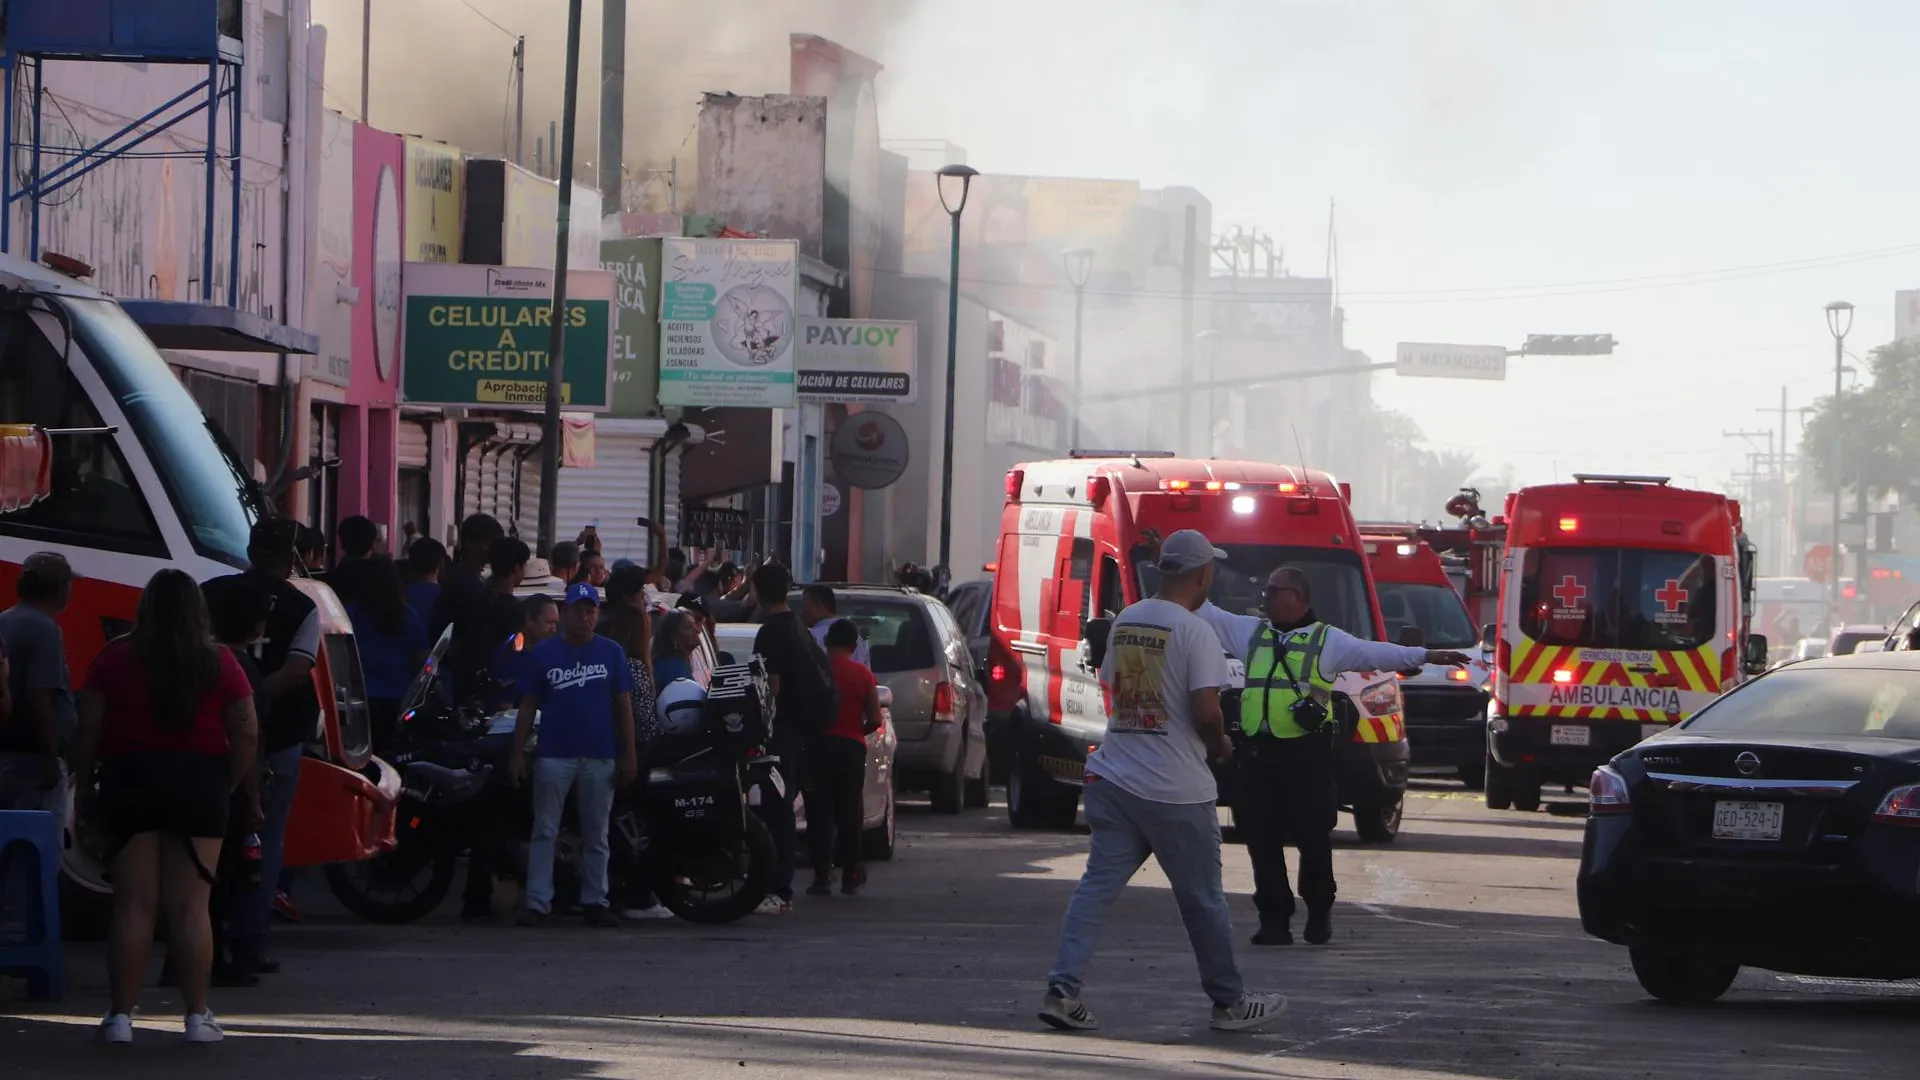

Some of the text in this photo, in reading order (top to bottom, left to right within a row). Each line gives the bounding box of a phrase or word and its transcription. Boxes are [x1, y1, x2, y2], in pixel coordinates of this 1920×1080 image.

[429, 306, 586, 327] CELULARS
[497, 328, 516, 349] A
[667, 335, 702, 344] INCIENSOS
[806, 325, 899, 347] PAYJOY
[613, 335, 637, 360] EL
[667, 347, 705, 356] VELADORAS
[448, 350, 549, 371] CREDIT
[666, 359, 698, 368] ESENCIAS
[835, 377, 849, 387] DE
[851, 377, 905, 390] CELULARES
[691, 511, 744, 525] TIENDA
[546, 661, 608, 688] Dodgers
[1550, 685, 1680, 709] AMBULANCIA
[674, 796, 714, 807] M-174
